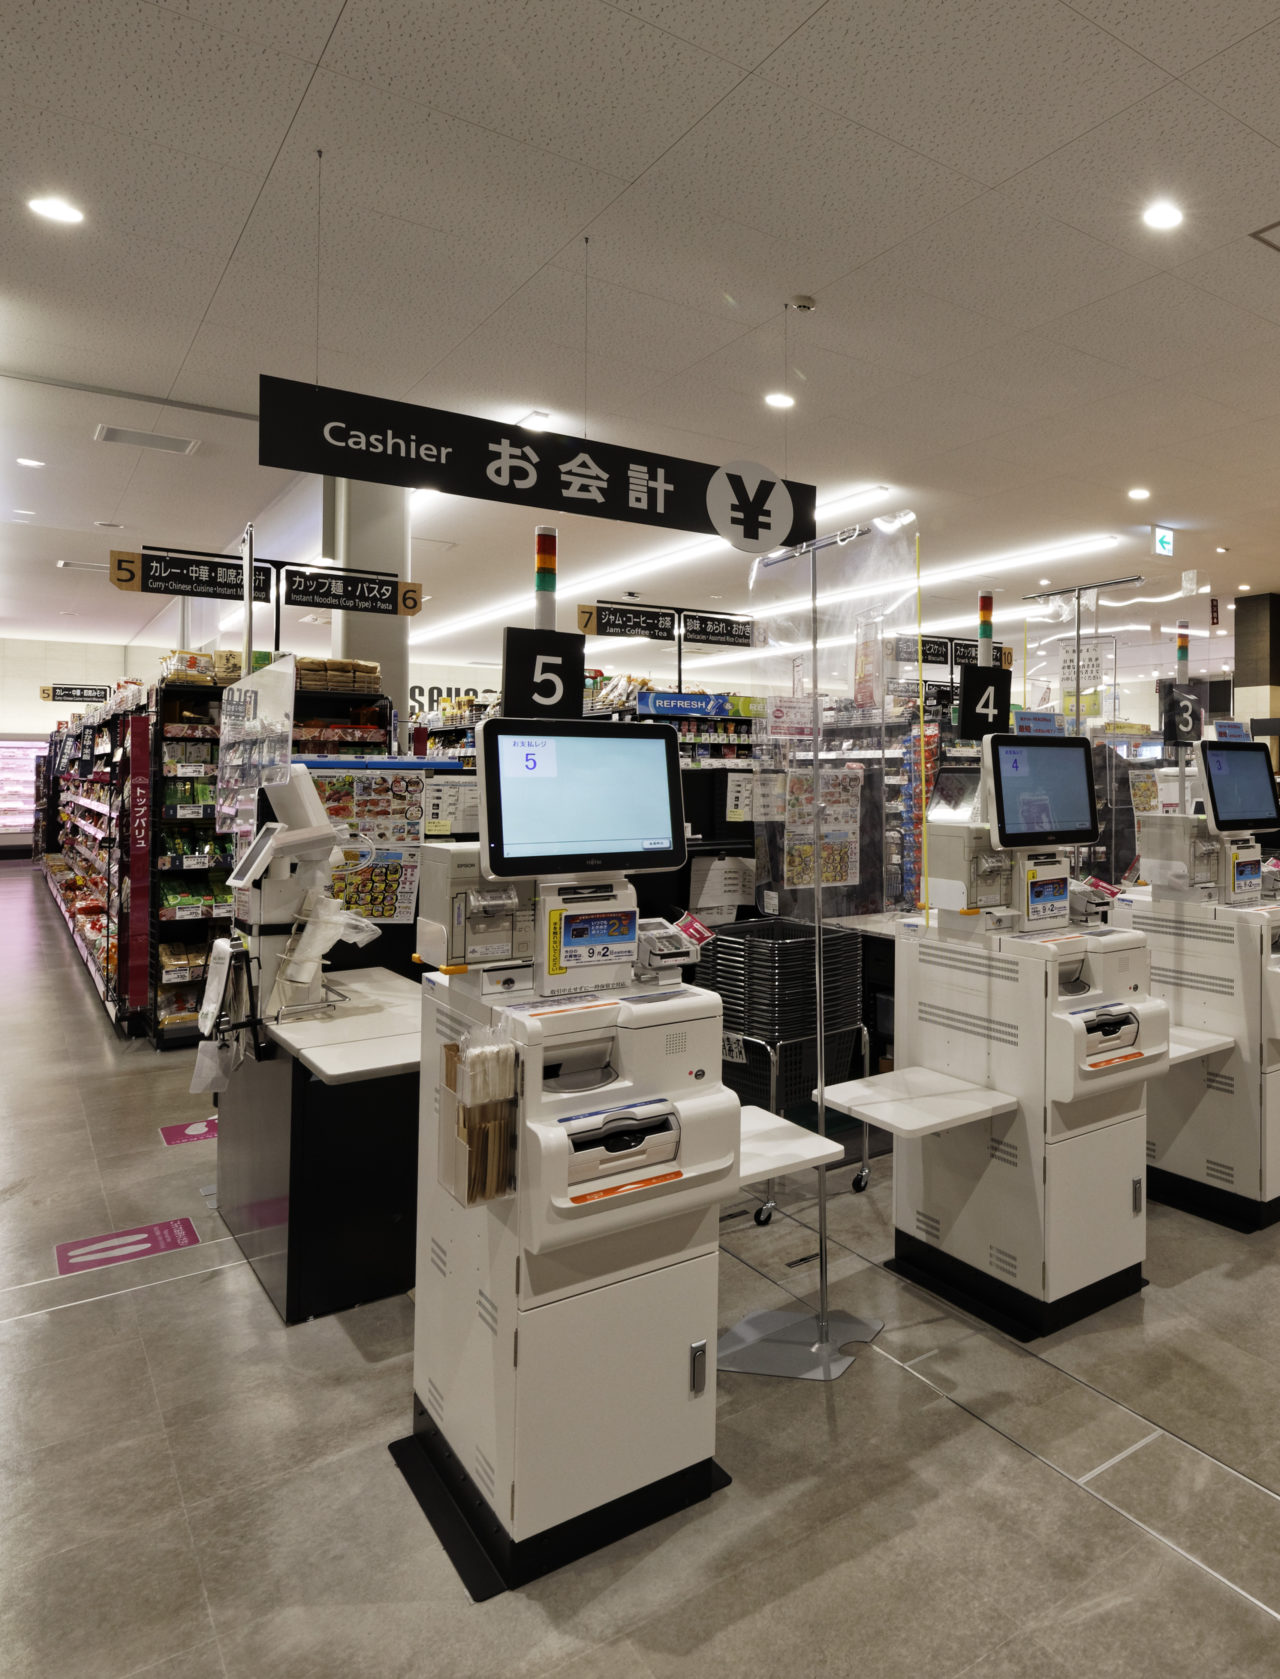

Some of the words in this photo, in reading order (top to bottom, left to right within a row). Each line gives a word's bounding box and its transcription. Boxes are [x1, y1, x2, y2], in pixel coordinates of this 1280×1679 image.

[323, 421, 452, 464] Cashier
[486, 438, 674, 514] お会計
[116, 559, 136, 582] 5
[150, 560, 265, 587] カレー・中華・即席み汁
[292, 576, 392, 600] カップ麺・パスタ
[291, 594, 313, 602] Instant
[314, 596, 339, 605] Noodles
[377, 601, 392, 610] Pasta
[402, 590, 418, 610] 6
[580, 611, 593, 628] 7
[601, 611, 672, 629] ジャム・コーヒー・お茶
[626, 627, 650, 635] Coffee
[1003, 652, 1012, 665] 10
[532, 656, 564, 705] 5
[42, 689, 50, 698] 5
[656, 699, 706, 709] REFRESH
[976, 686, 997, 722] 4
[1178, 700, 1193, 732] 3
[525, 753, 537, 770] 5
[1012, 758, 1019, 772] 4
[1216, 760, 1222, 771] 3
[134, 787, 147, 848] トップバリュ
